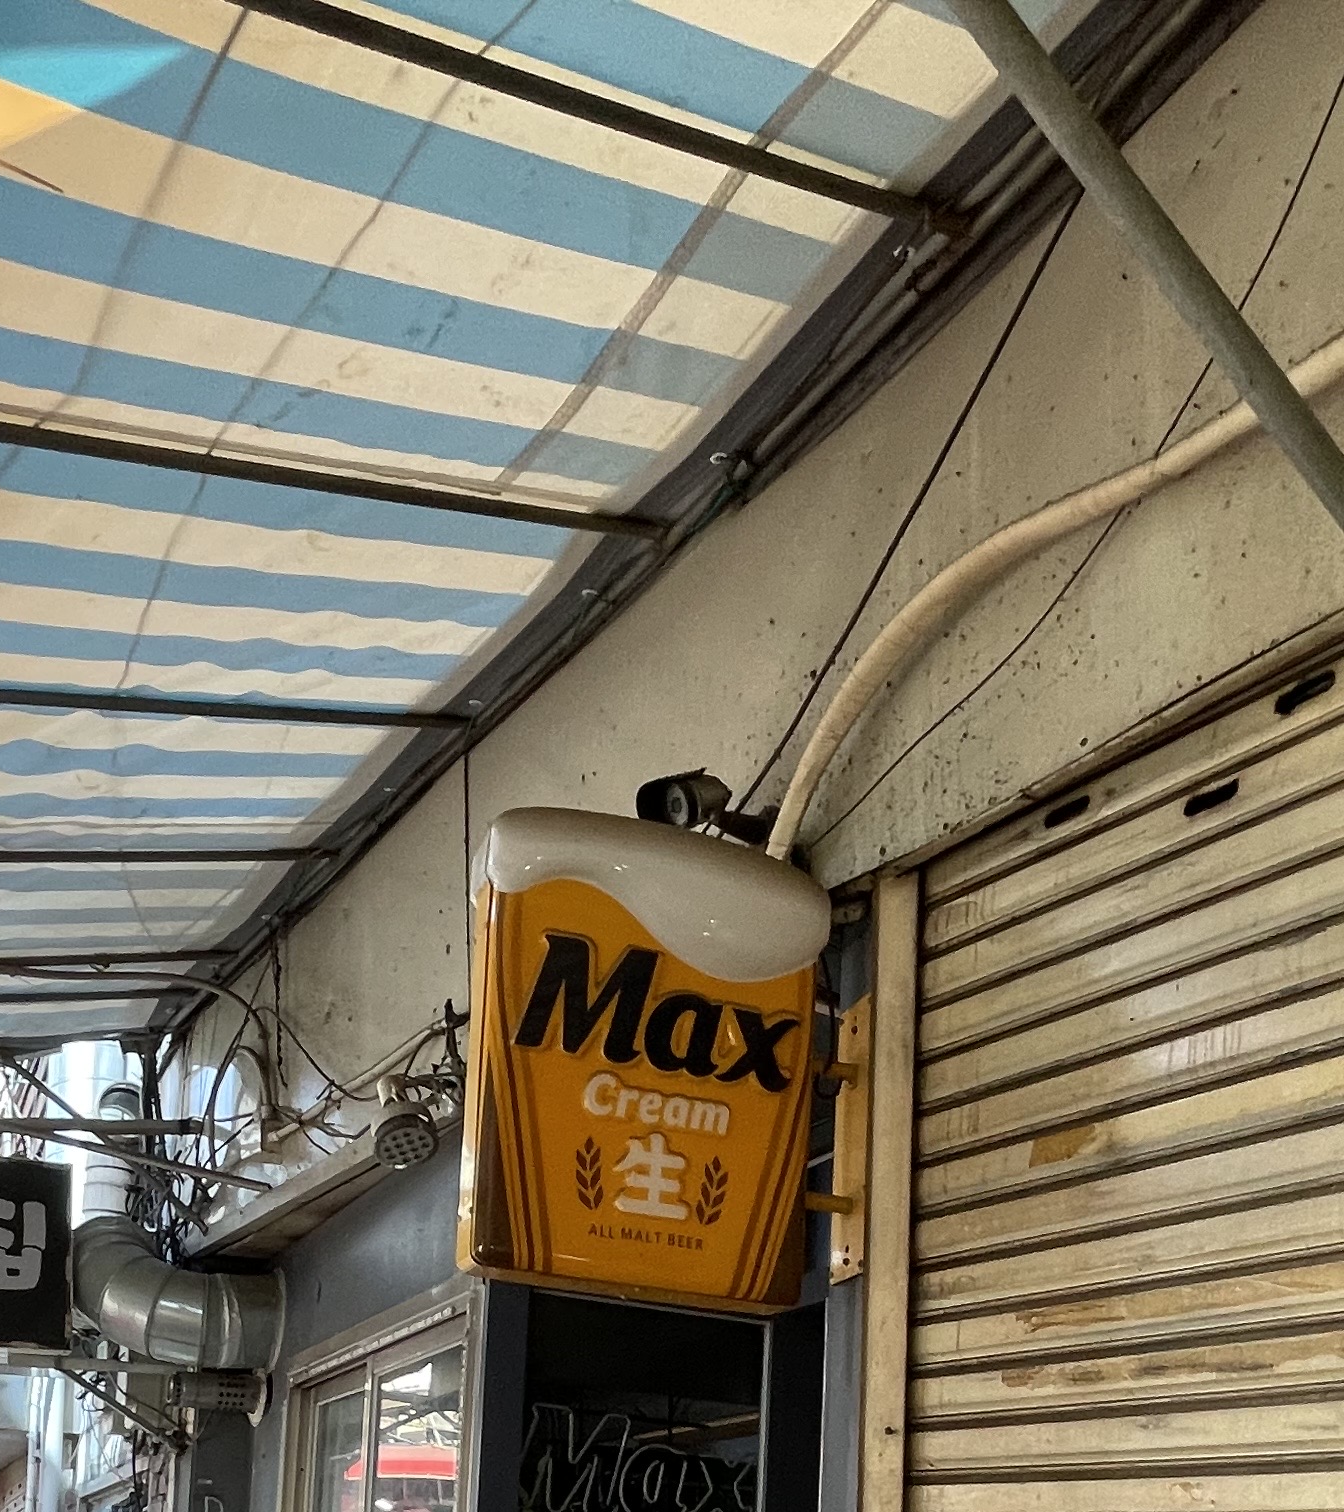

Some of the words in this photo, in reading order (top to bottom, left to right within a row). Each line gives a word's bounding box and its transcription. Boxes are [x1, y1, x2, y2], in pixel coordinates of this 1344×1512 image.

[514, 932, 801, 1093] Max
[583, 1072, 730, 1136] Cream
[613, 1134, 690, 1221] 生
[588, 1223, 615, 1239] ALL
[620, 1227, 662, 1244] MALT
[667, 1233, 704, 1251] BEER
